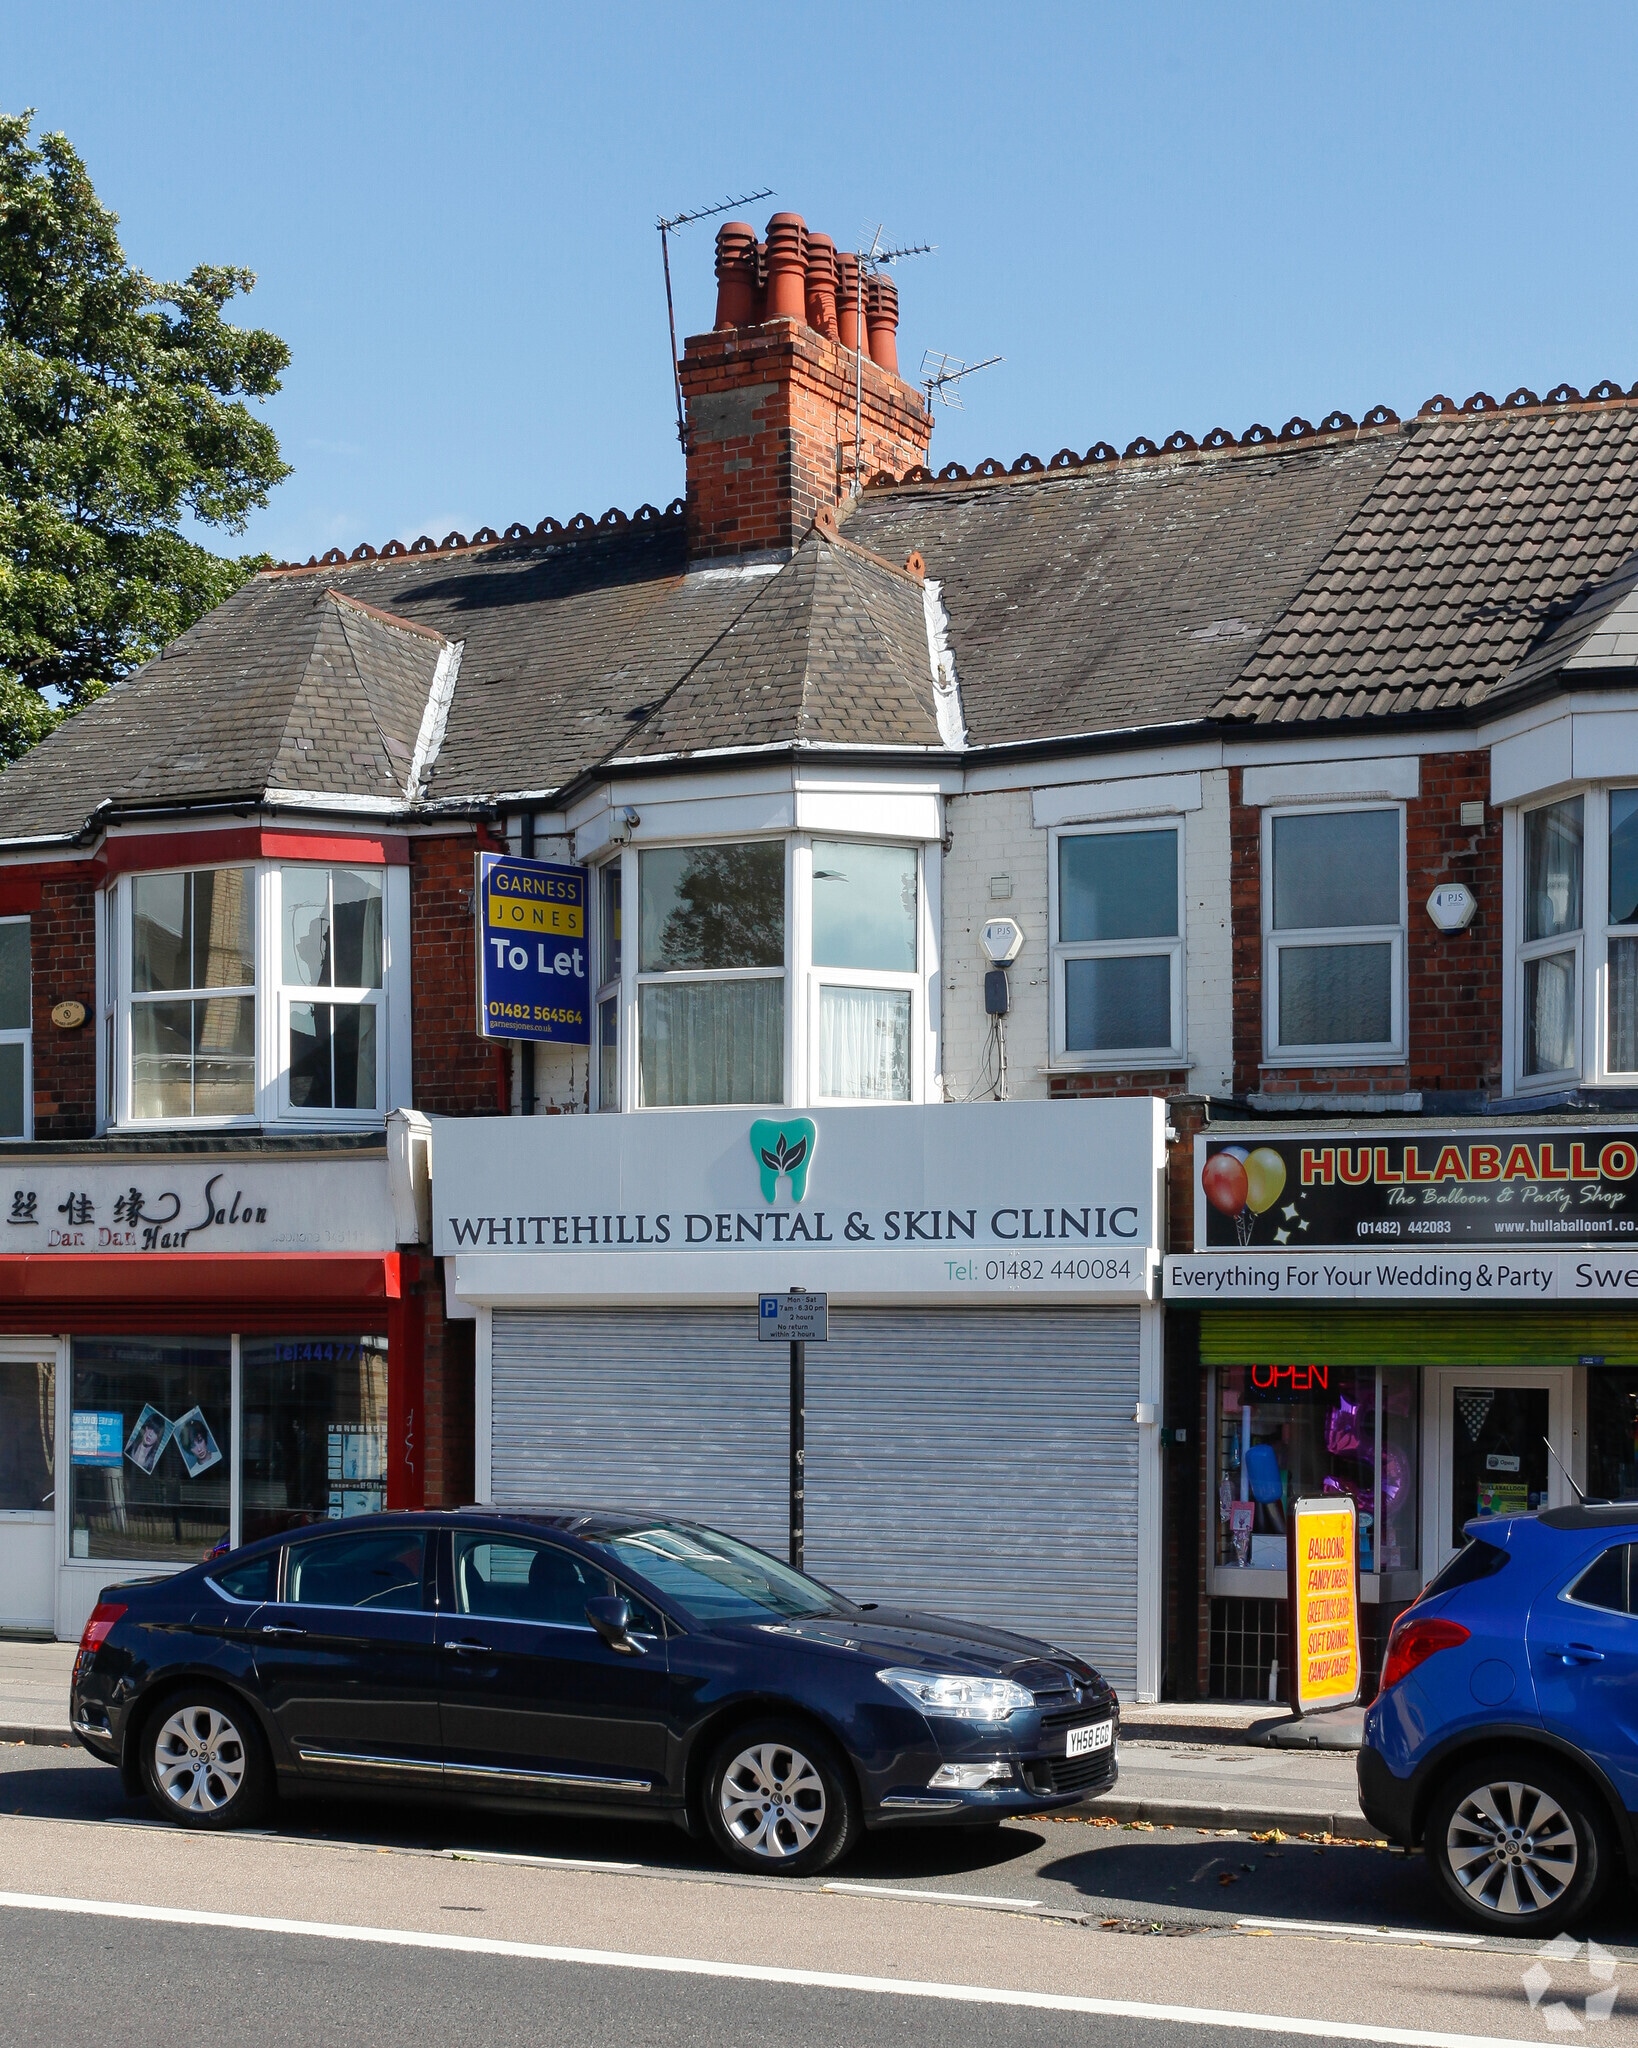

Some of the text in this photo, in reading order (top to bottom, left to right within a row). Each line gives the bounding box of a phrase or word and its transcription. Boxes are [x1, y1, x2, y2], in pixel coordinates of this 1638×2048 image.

[496, 873, 577, 899] GARNESS
[1448, 893, 1463, 901] PJS
[496, 904, 577, 929] JONES
[997, 927, 1011, 935] PJS
[490, 937, 585, 978] To Let
[489, 1001, 583, 1025] 01482 564564
[489, 1020, 553, 1033] garnessjones.co.uk
[1300, 1140, 1638, 1186] HULLABALLO
[48, 1173, 268, 1250] Dan Dan Hair Salon
[1386, 1185, 1625, 1213] The Balloon & Party Shop
[448, 1207, 1139, 1246] WHITEHILLS DENTAL & SKIN CLINIC
[1356, 1221, 1402, 1236] (01482)
[1407, 1221, 1451, 1234] 442083
[944, 1258, 1131, 1281] Tel: 01482 440084
[1172, 1264, 1553, 1291] Everything For Your Wedding & Party
[1307, 1536, 1345, 1561] BALLOONS
[1307, 1567, 1349, 1591] FANCY DRESS
[1307, 1598, 1336, 1624] GREETINGS
[1308, 1628, 1349, 1655] SOFT DRINKS
[1308, 1655, 1351, 1683] CANDY CARTS
[1070, 1728, 1094, 1752] YH58
